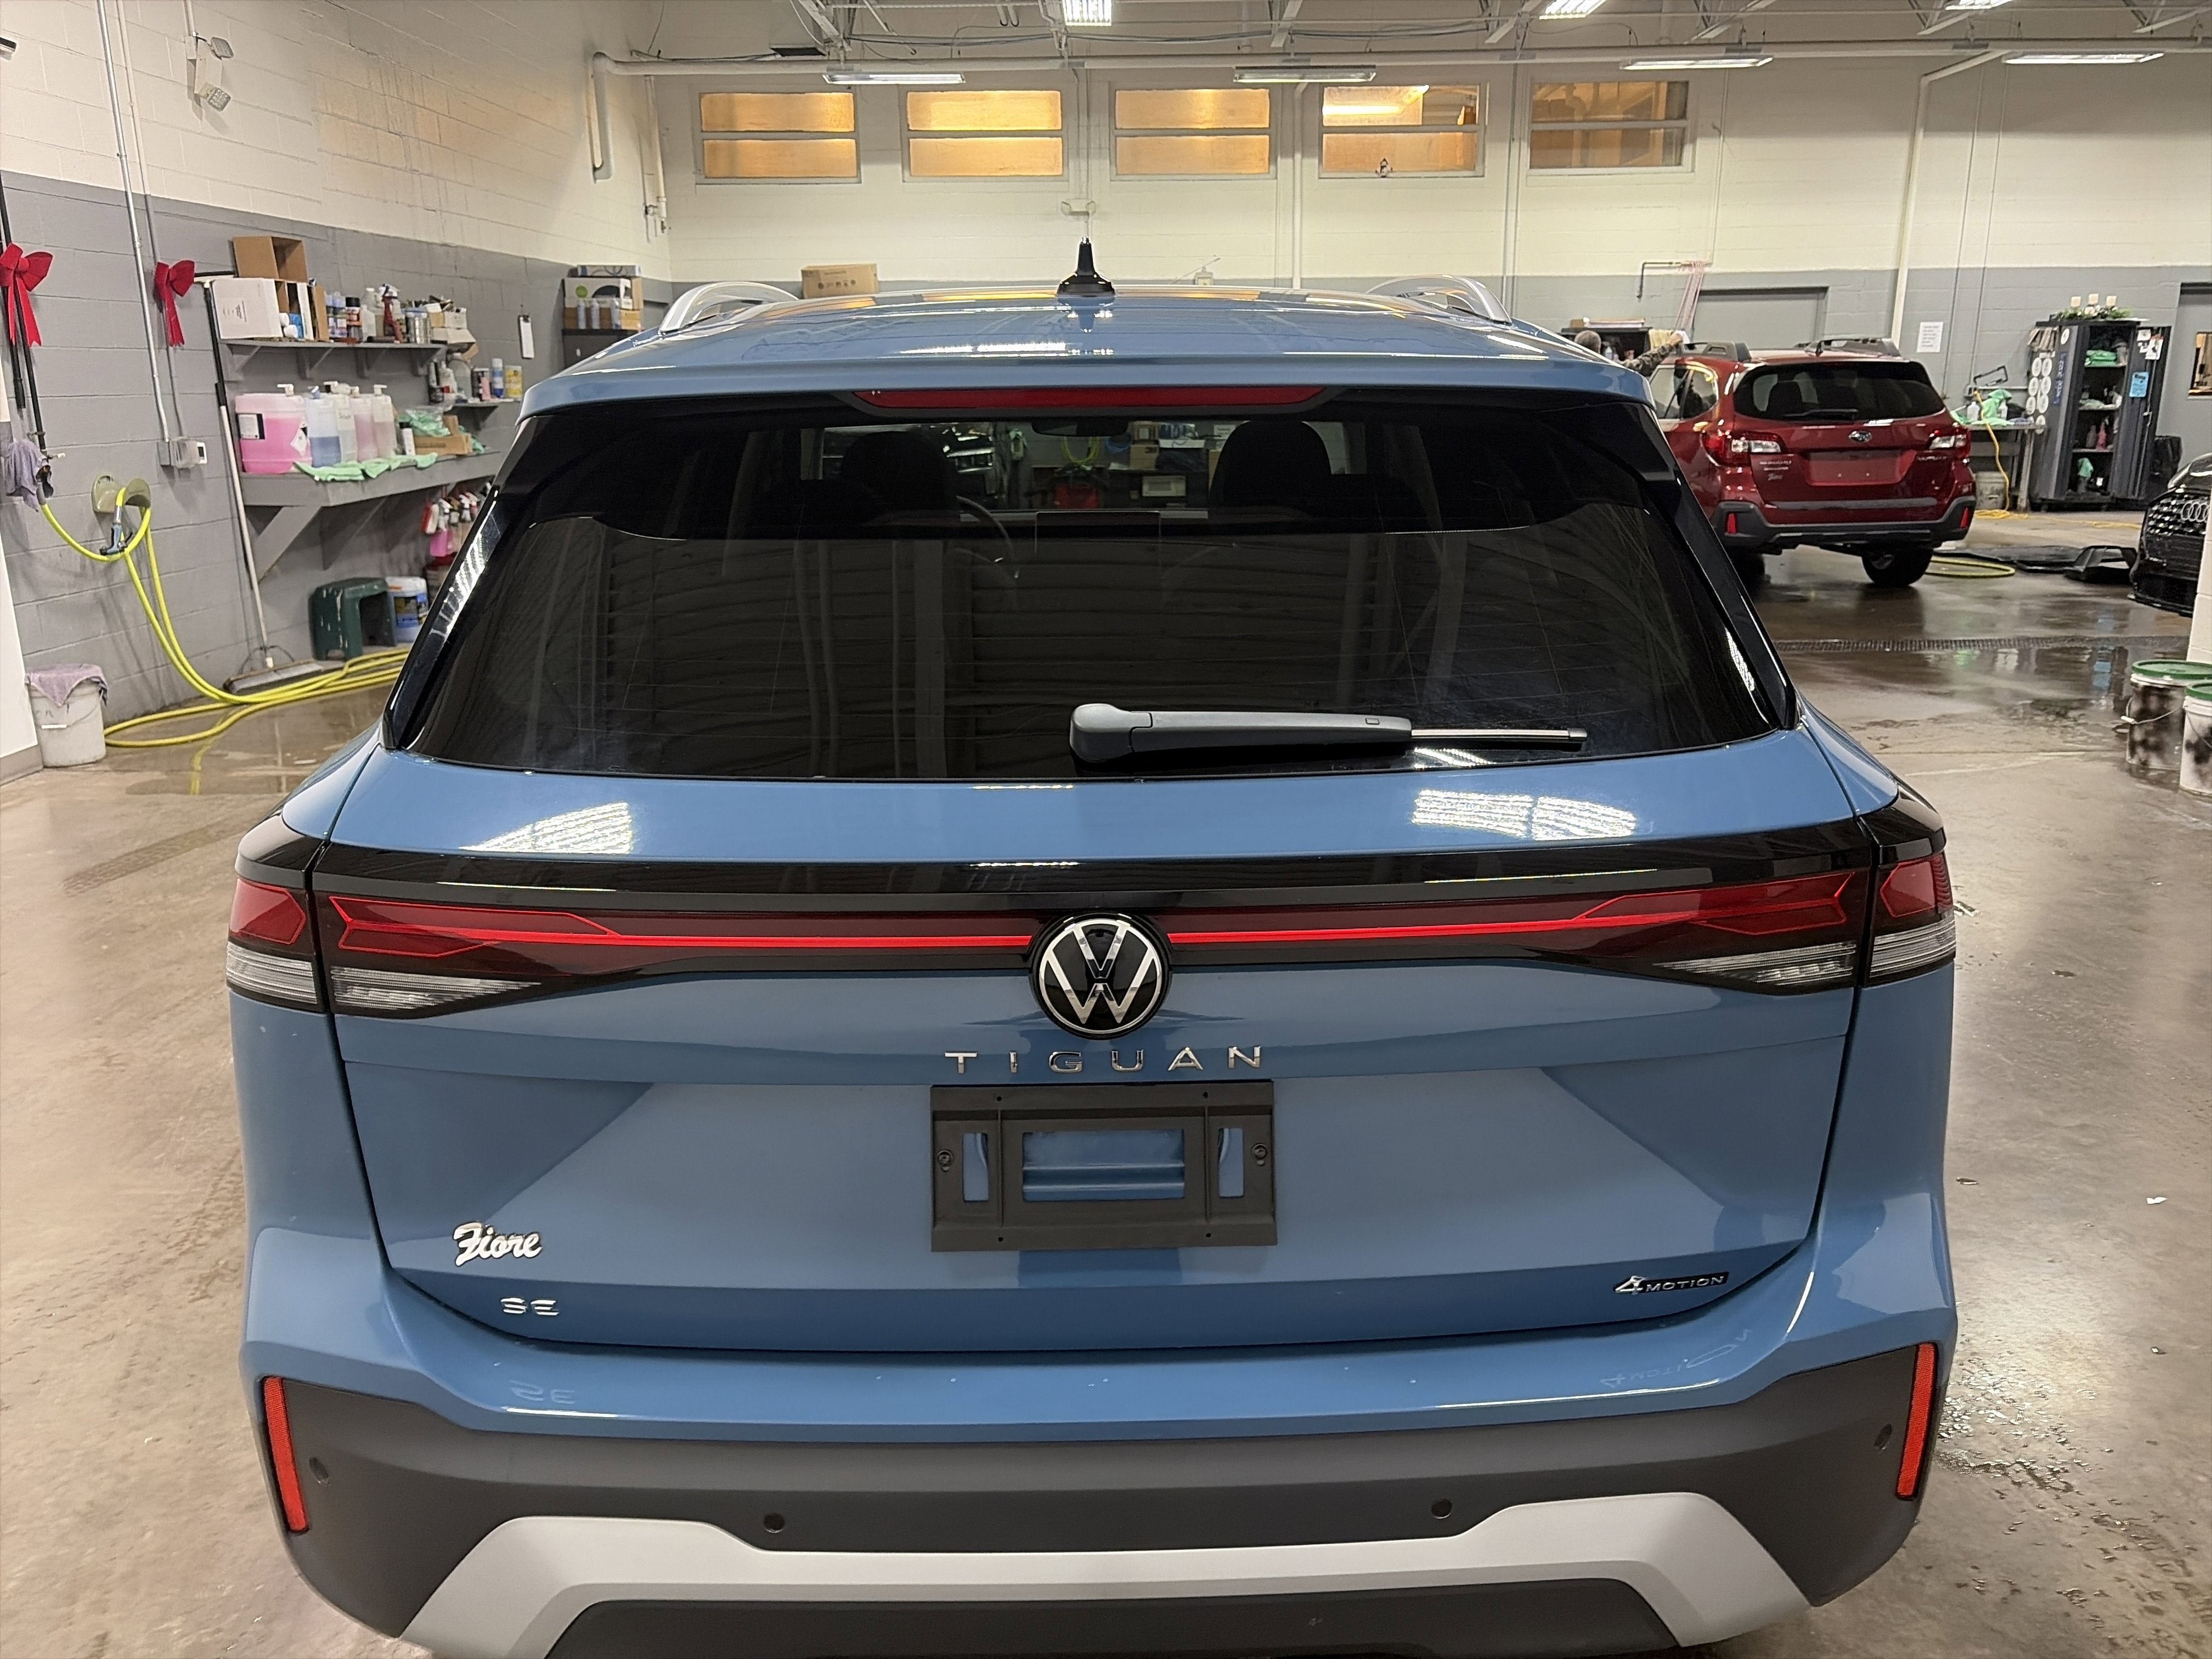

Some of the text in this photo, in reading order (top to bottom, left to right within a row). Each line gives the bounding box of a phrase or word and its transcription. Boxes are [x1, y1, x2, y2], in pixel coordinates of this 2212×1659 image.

[944, 1045, 1262, 1074] TIGUAN
[453, 1221, 543, 1267] Fiore
[500, 1296, 560, 1316] SE
